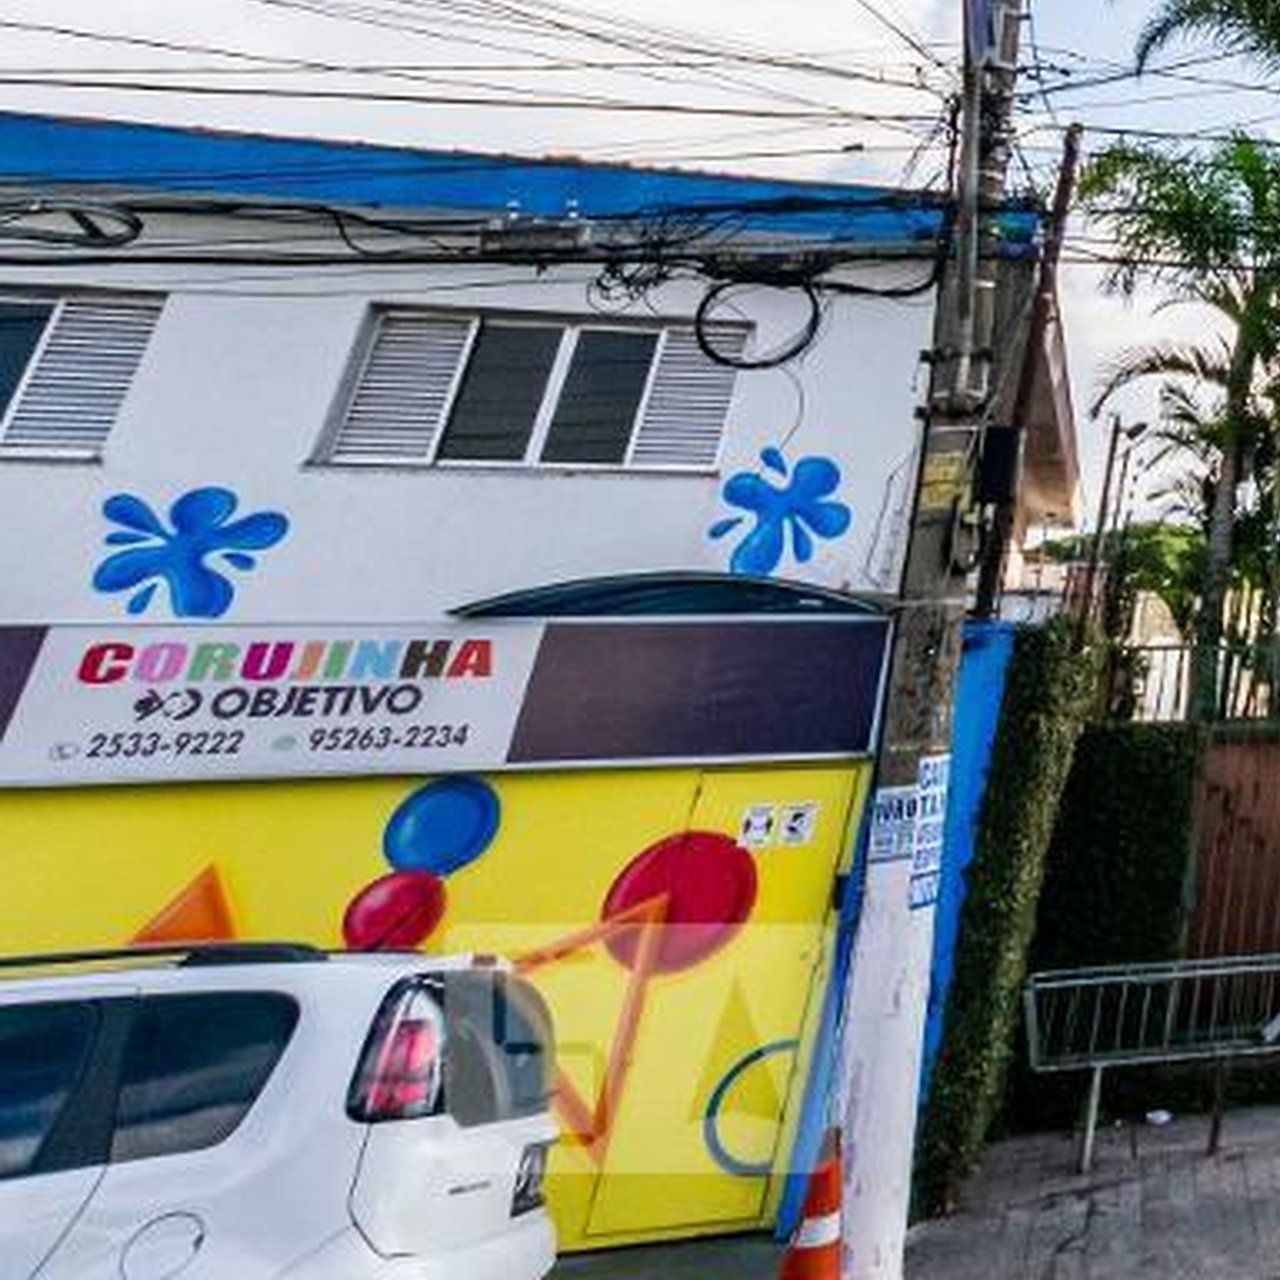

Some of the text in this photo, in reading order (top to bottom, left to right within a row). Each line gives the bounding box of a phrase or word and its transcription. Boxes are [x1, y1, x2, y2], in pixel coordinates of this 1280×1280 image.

[77, 639, 492, 685] CORUJINHA
[210, 684, 423, 719] OBJETIVO
[85, 723, 469, 759] 2533-9222 95263-2234
